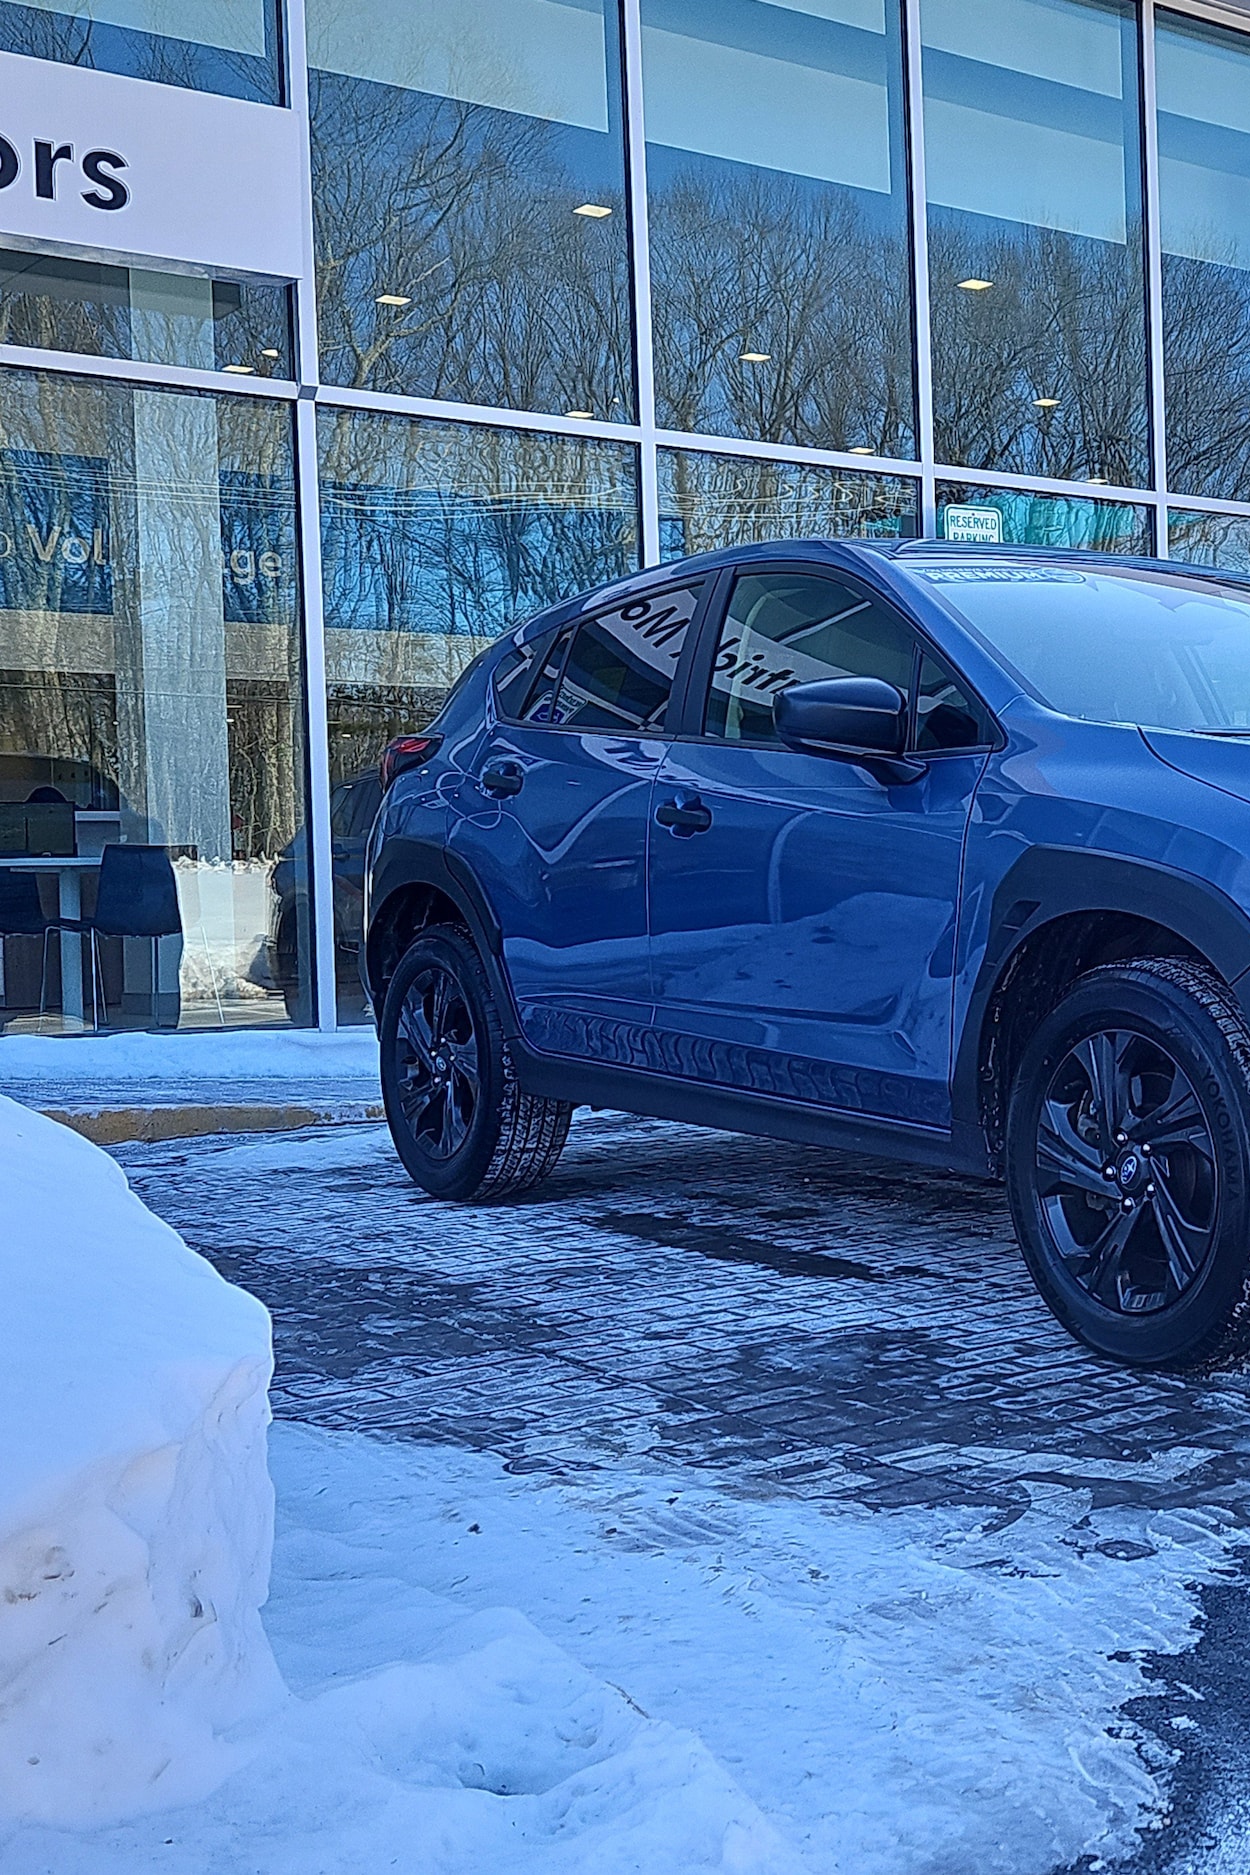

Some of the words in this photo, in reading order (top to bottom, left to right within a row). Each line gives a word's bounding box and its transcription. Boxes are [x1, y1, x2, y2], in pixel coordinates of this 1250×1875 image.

[949, 515, 997, 531] RESERVED
[953, 531, 995, 542] PARKING
[1202, 1066, 1242, 1199] YOKOHAMA
